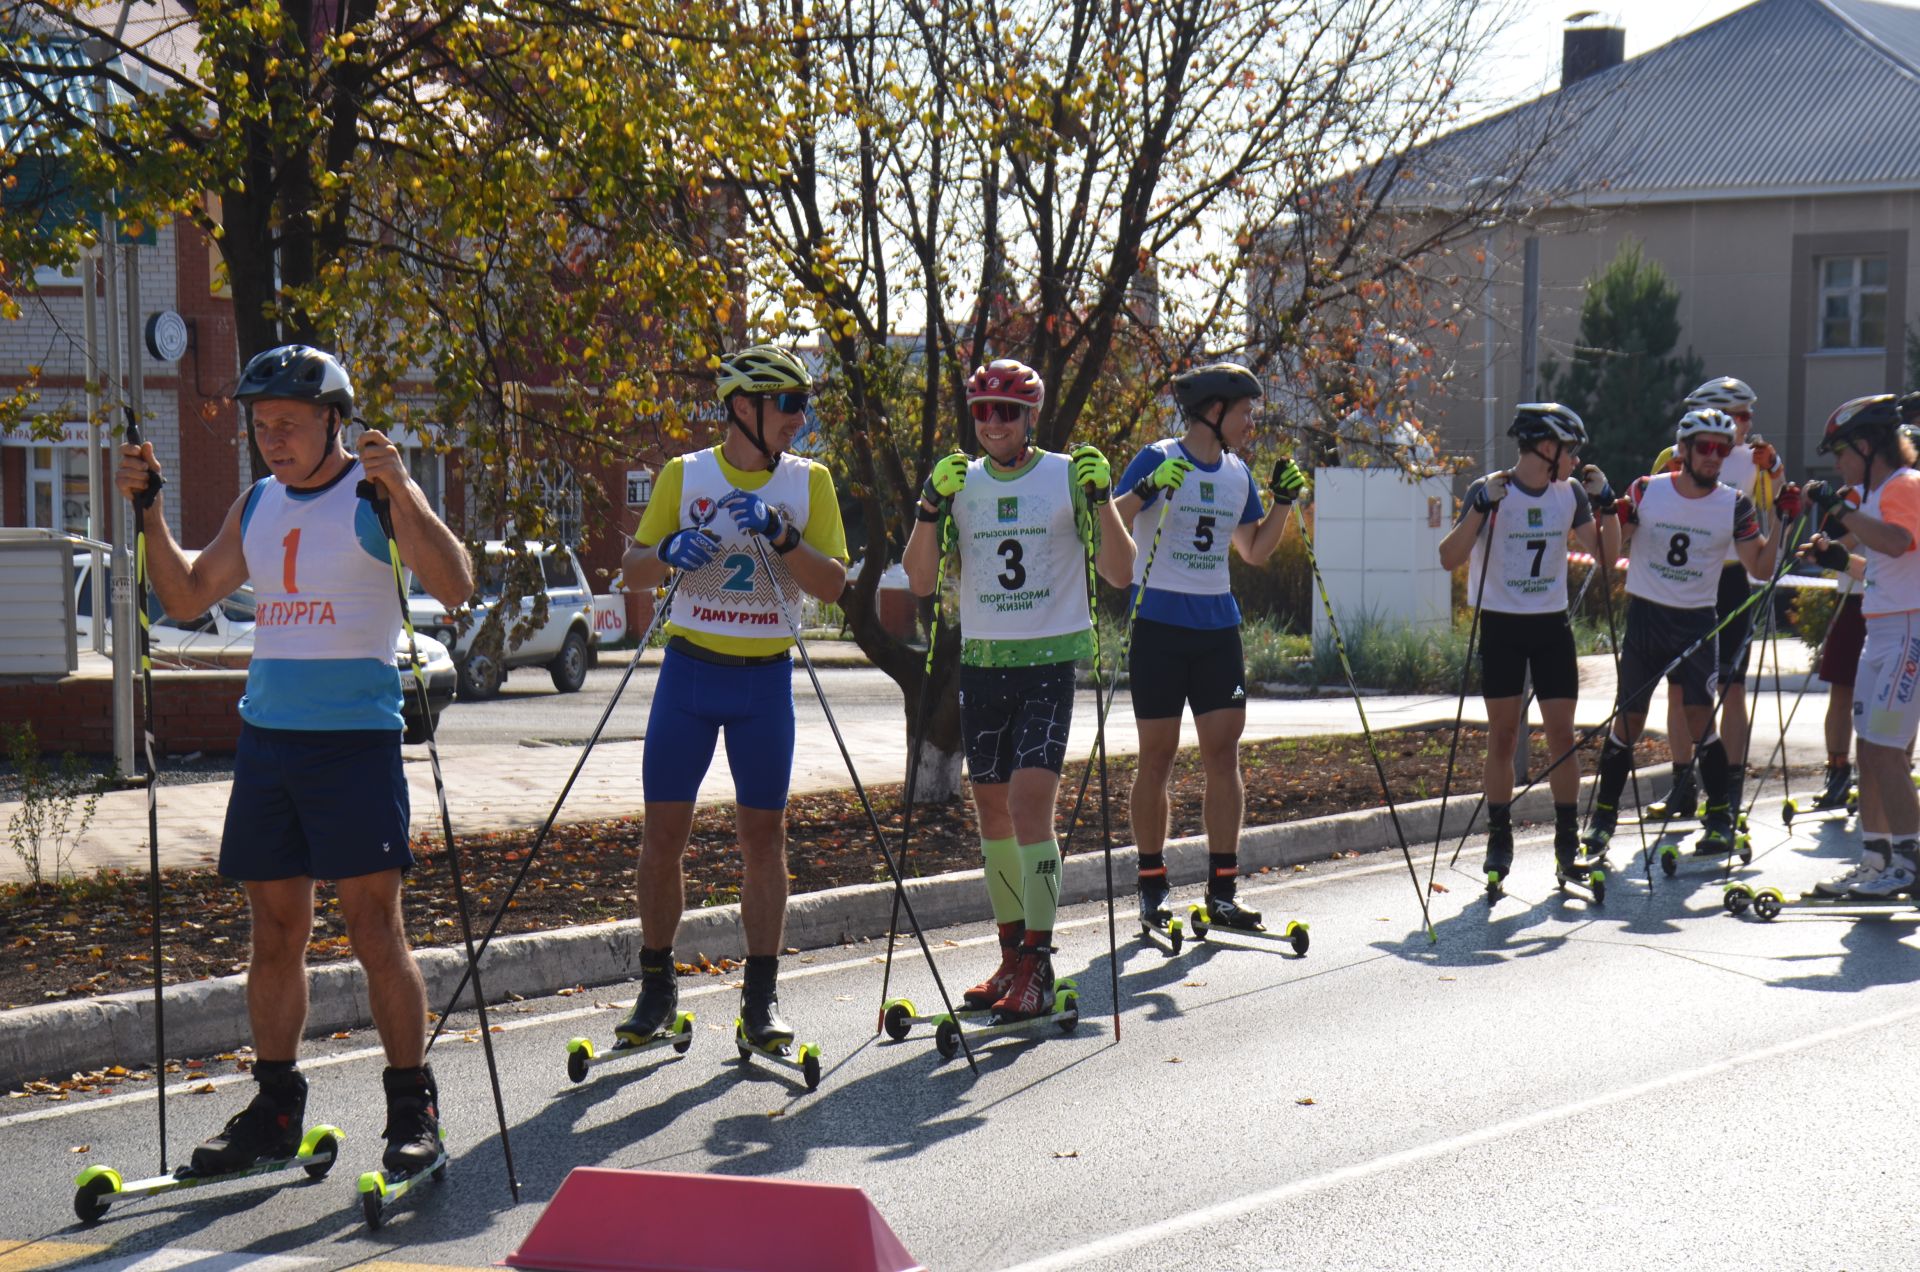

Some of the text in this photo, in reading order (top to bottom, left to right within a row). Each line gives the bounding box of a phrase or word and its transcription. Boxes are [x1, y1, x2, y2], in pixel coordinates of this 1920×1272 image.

[973, 526, 1047, 539] АГРЫЗСКИЙ РАЙОН
[1193, 515, 1216, 552] 5
[1667, 532, 1690, 567] 8
[282, 528, 301, 594] 1
[720, 553, 755, 592] 2
[997, 538, 1026, 590] 3
[1526, 539, 1547, 577] 7
[980, 588, 1051, 604] СПОРТ НОРМА
[995, 600, 1034, 613] ЖИЗНИ
[691, 605, 779, 625] УДМУРТИЯ
